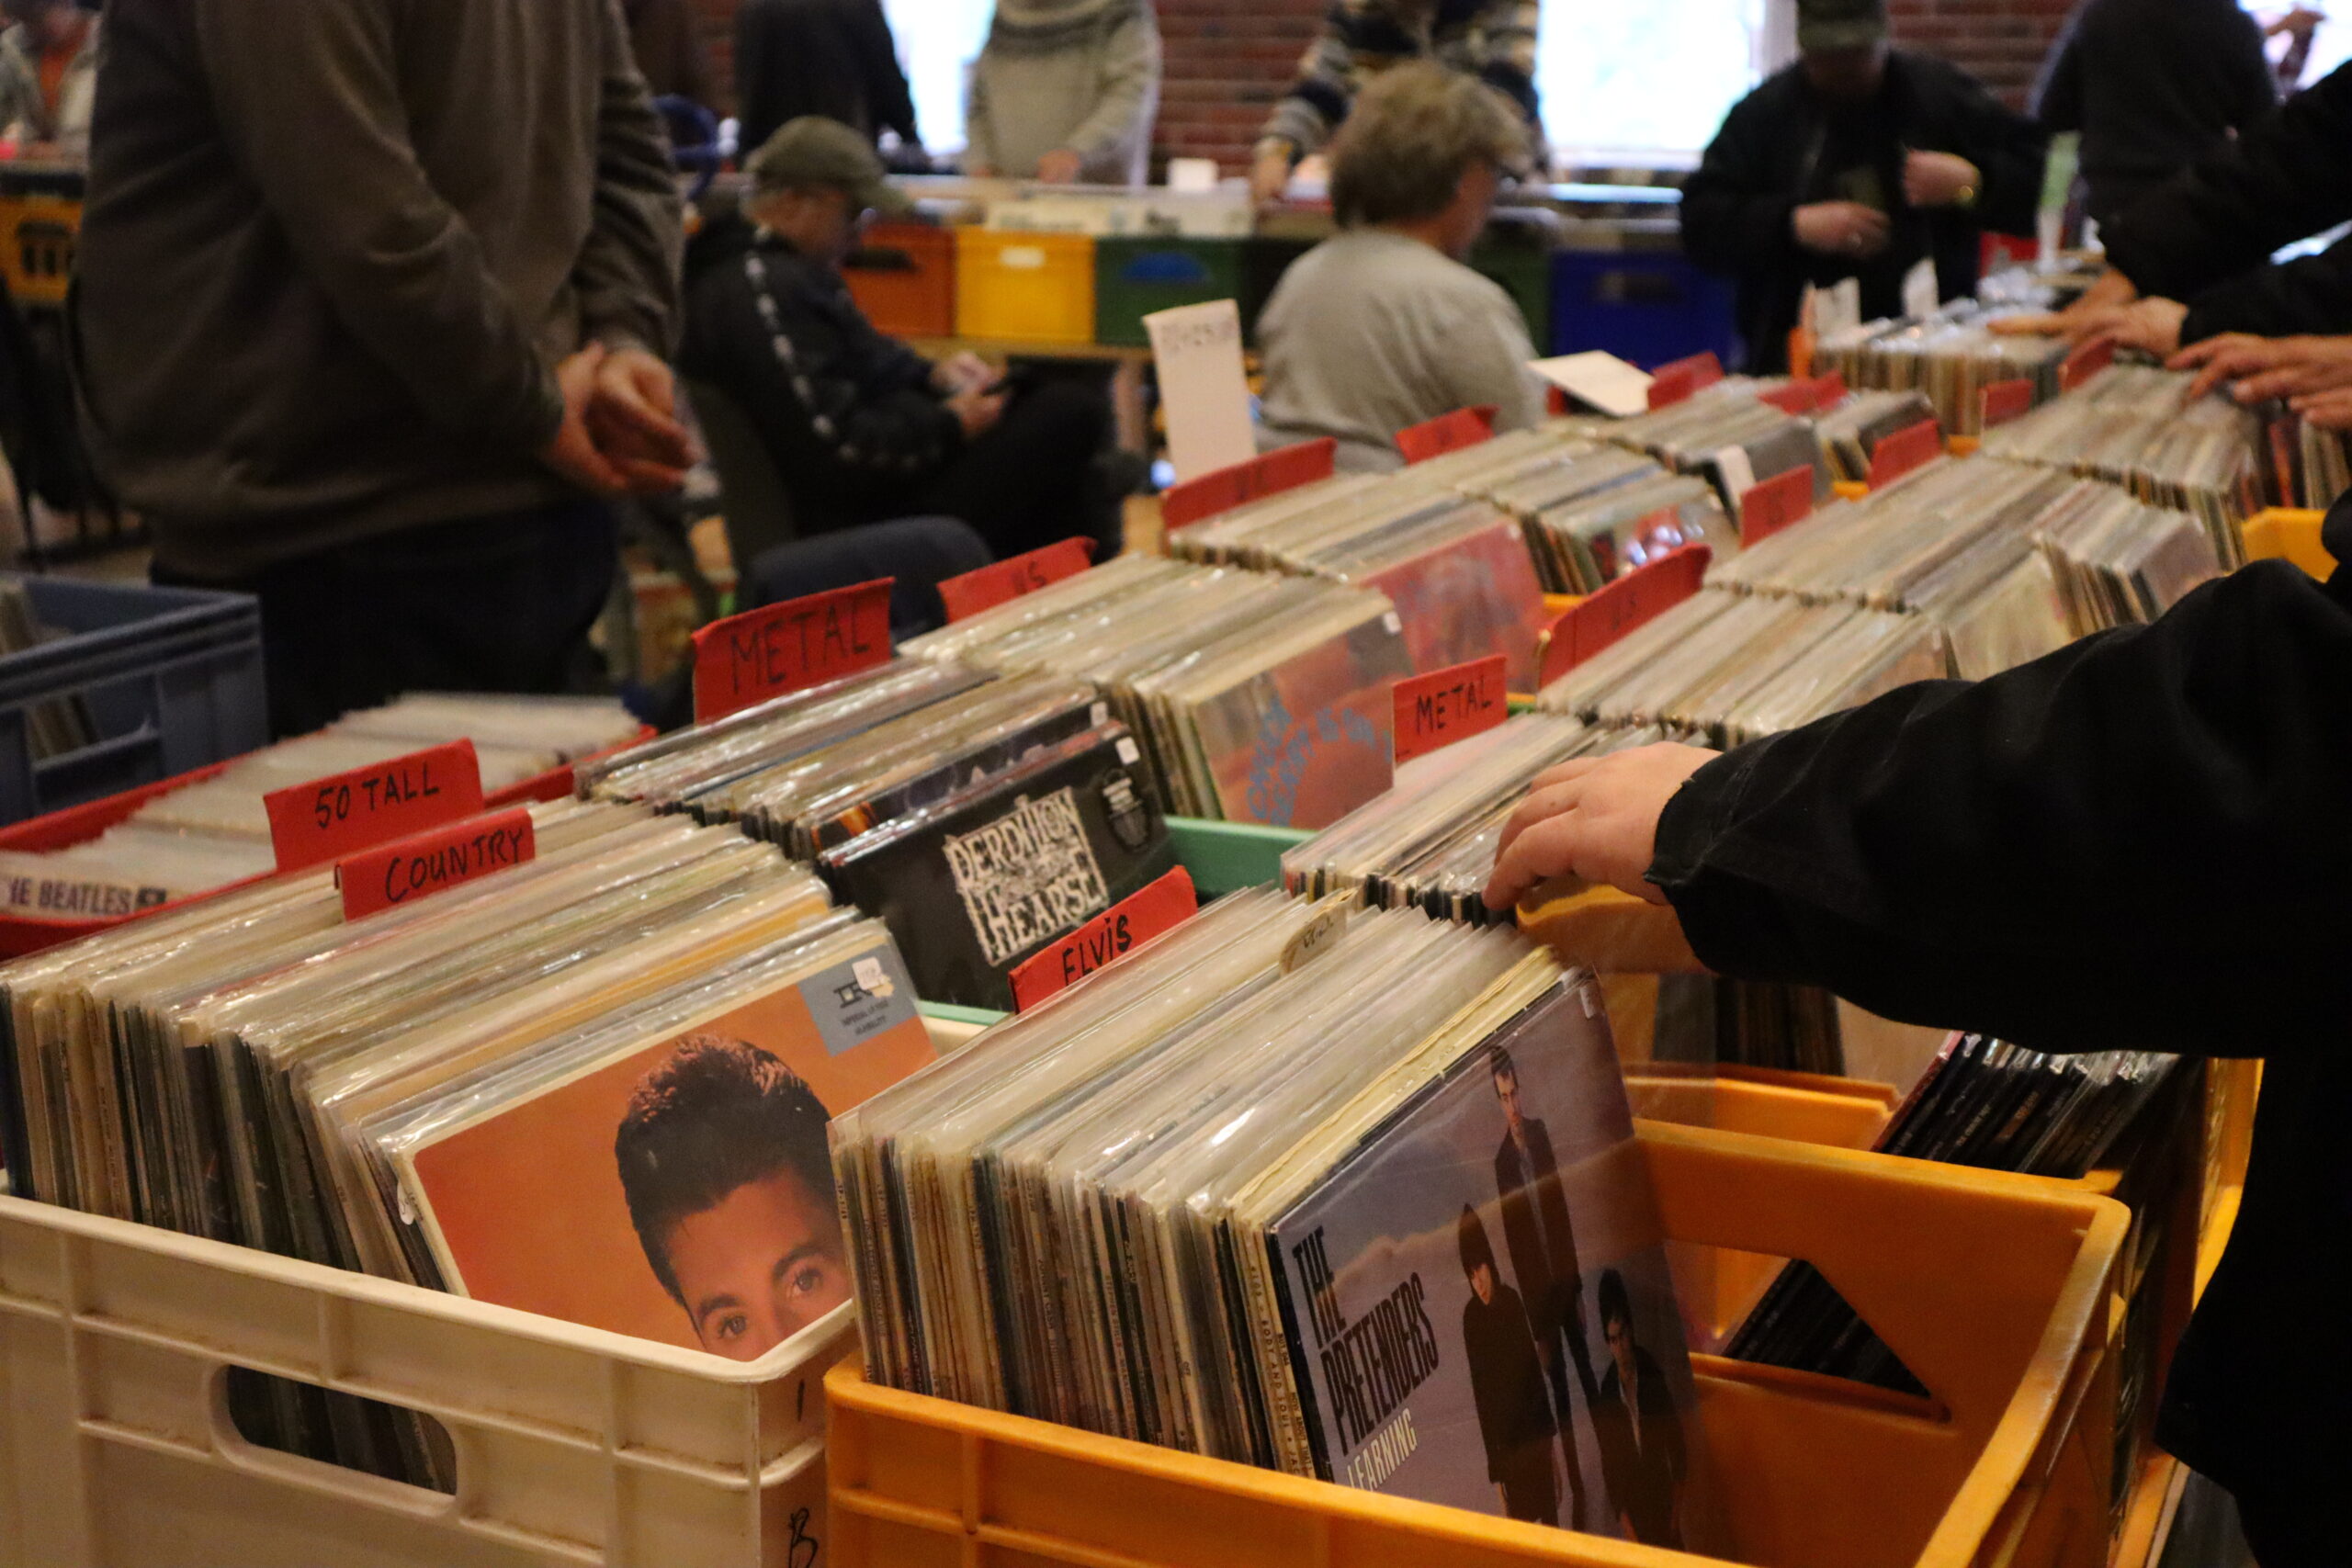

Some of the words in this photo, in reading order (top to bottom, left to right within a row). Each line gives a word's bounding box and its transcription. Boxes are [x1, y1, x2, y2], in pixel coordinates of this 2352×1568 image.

[730, 602, 869, 694] METAL
[1415, 673, 1492, 734] METAL
[315, 784, 350, 829] 50
[362, 761, 440, 811] TALL
[385, 829, 523, 903] COUNTRY
[1292, 1224, 1347, 1349] THE
[1319, 1271, 1440, 1458] PRETENDERS
